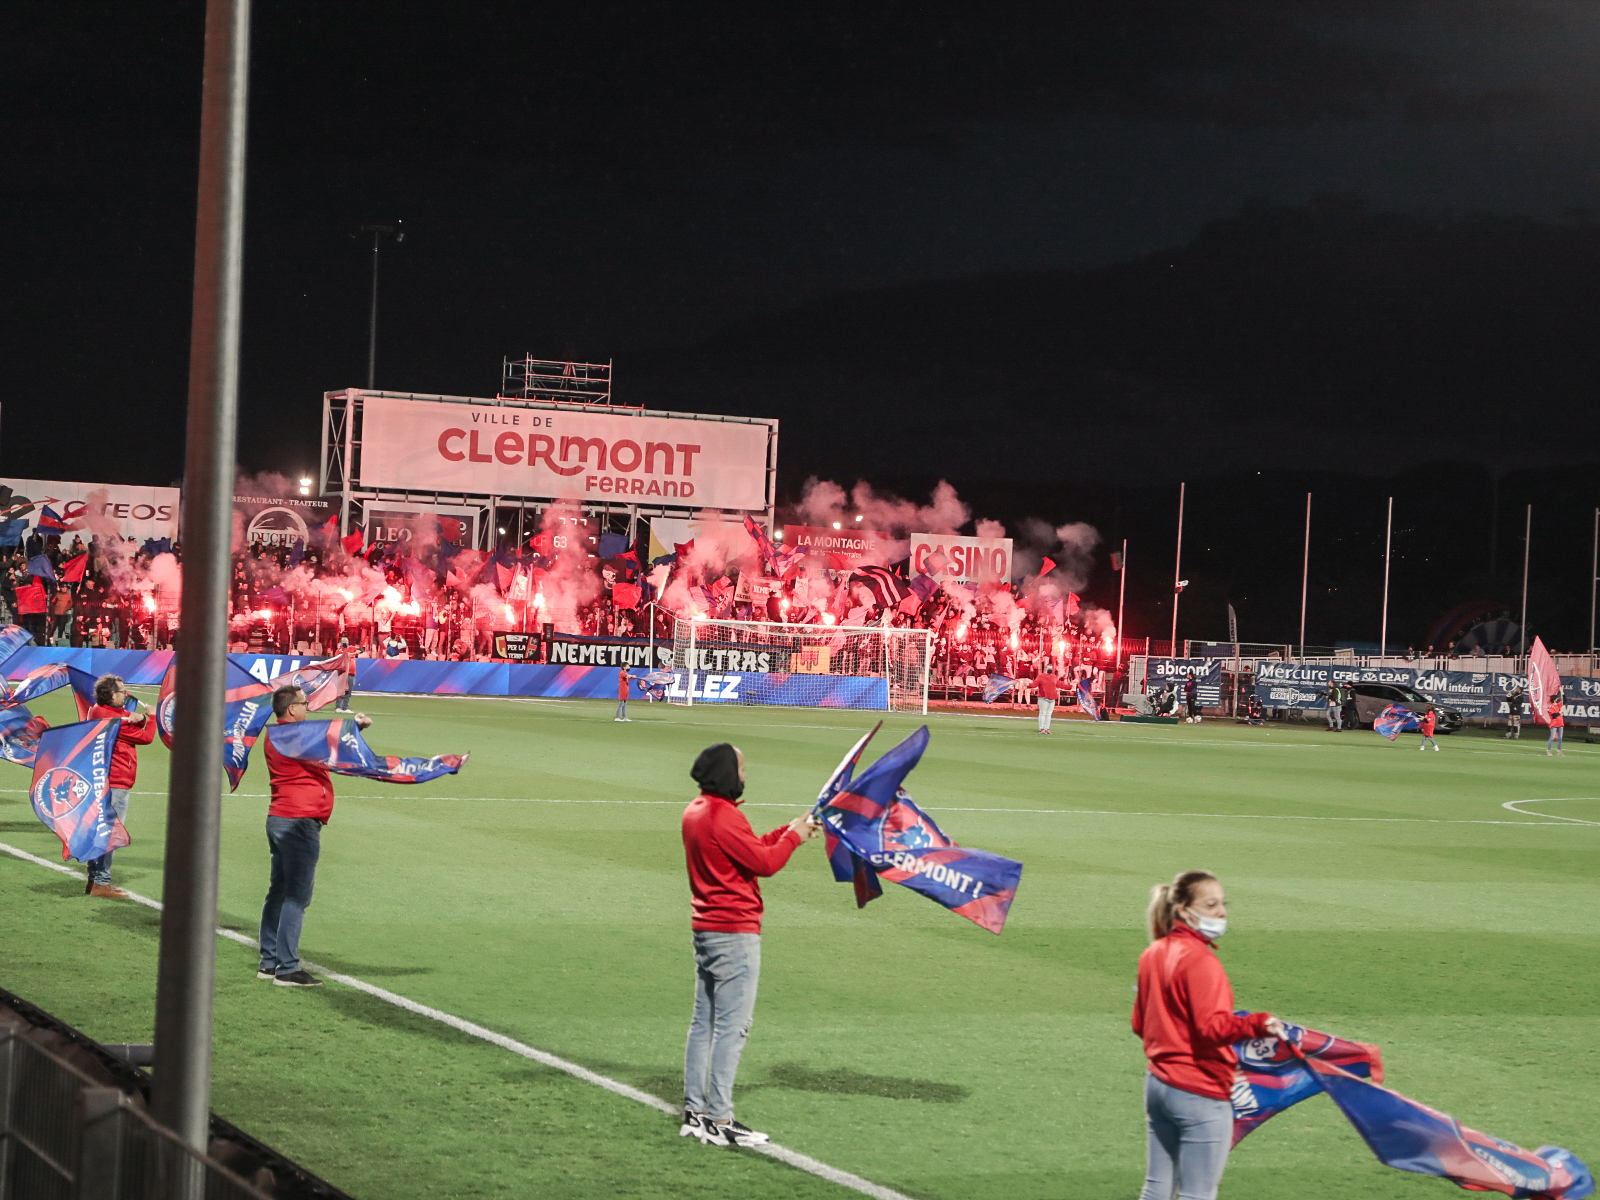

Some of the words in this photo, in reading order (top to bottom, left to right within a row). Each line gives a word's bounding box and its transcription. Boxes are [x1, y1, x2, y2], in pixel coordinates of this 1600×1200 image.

[471, 412, 520, 426] VILLE
[533, 416, 553, 427] DE
[232, 496, 283, 505] RESTAURANT
[289, 499, 329, 508] TRAITEUR
[63, 500, 173, 522] CTEOS
[553, 535, 567, 548] 63
[797, 535, 812, 546] LA
[813, 536, 876, 551] MONTAGNE
[914, 543, 1007, 579] CSINO
[551, 642, 651, 666] NEMETUM
[685, 649, 770, 673] ULTRAS
[1156, 660, 1209, 676] abicom
[1260, 664, 1328, 681] Mercure
[1333, 670, 1360, 681] CF2C
[1379, 672, 1410, 683] C2AP
[655, 673, 742, 699] LLEZ
[1414, 673, 1448, 691] CdM
[1448, 683, 1484, 694] intérim
[870, 851, 974, 895] CLERMONT
